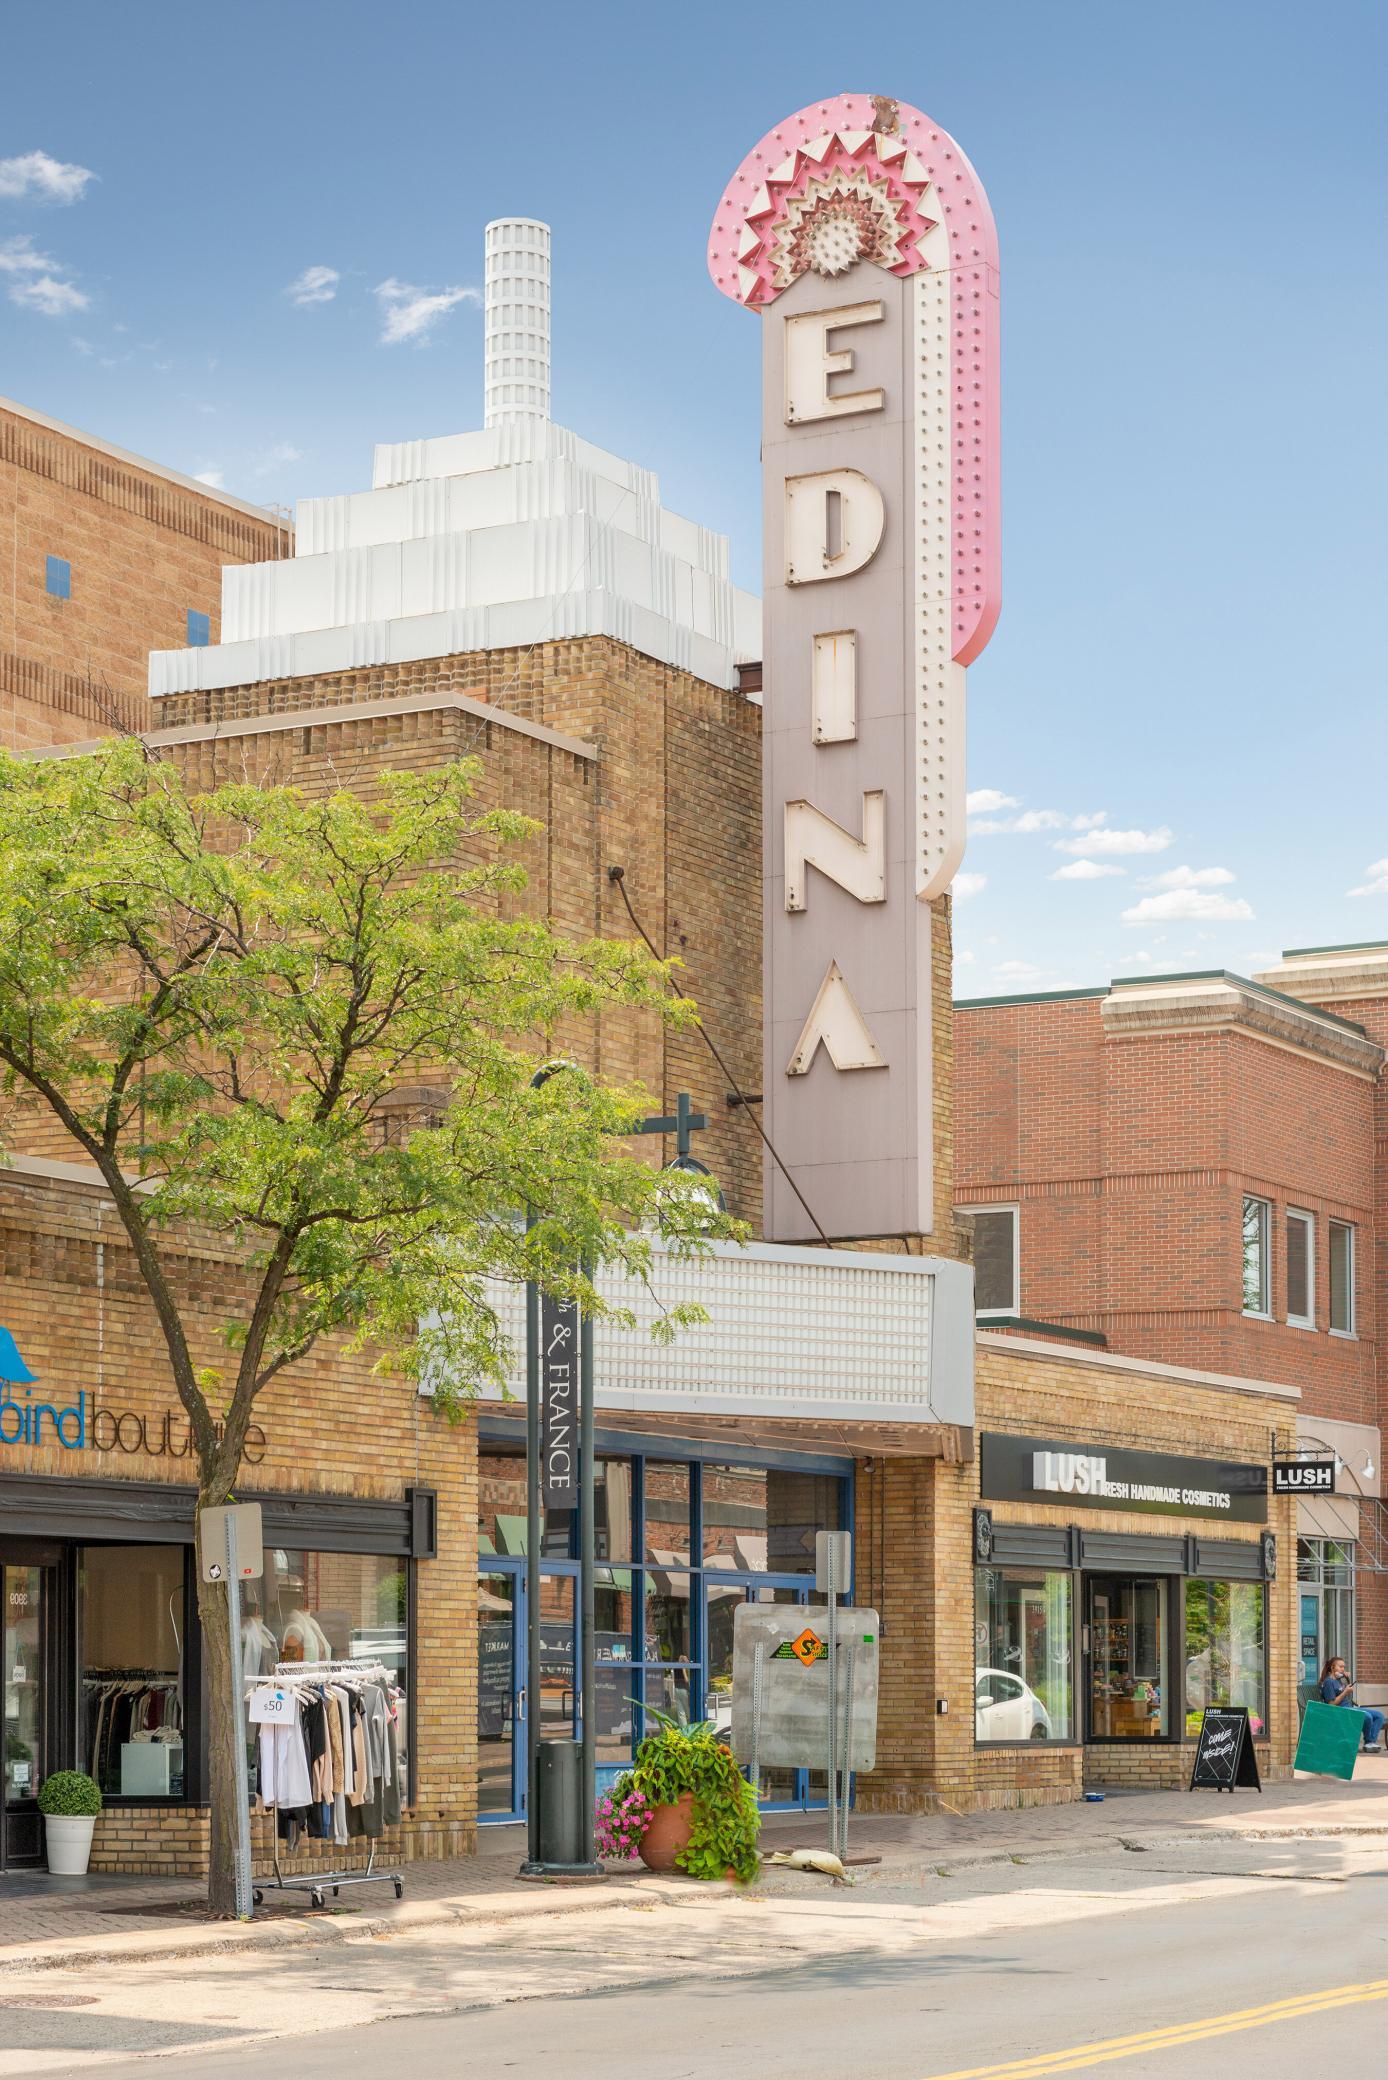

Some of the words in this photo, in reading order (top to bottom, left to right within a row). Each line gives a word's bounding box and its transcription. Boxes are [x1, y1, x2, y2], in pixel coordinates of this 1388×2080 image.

[784, 299, 889, 1077] EDINA
[547, 1323, 571, 1356] &
[549, 1363, 571, 1489] FRANCE
[1033, 1451, 1106, 1496] LUSH
[1276, 1468, 1331, 1484] LUSH
[1104, 1481, 1129, 1499] RESH
[1130, 1483, 1181, 1504] HANDMADE
[1182, 1488, 1231, 1509] COSMETICS
[1202, 1741, 1235, 1759] INSIDE!
[1208, 1728, 1232, 1744] COME
